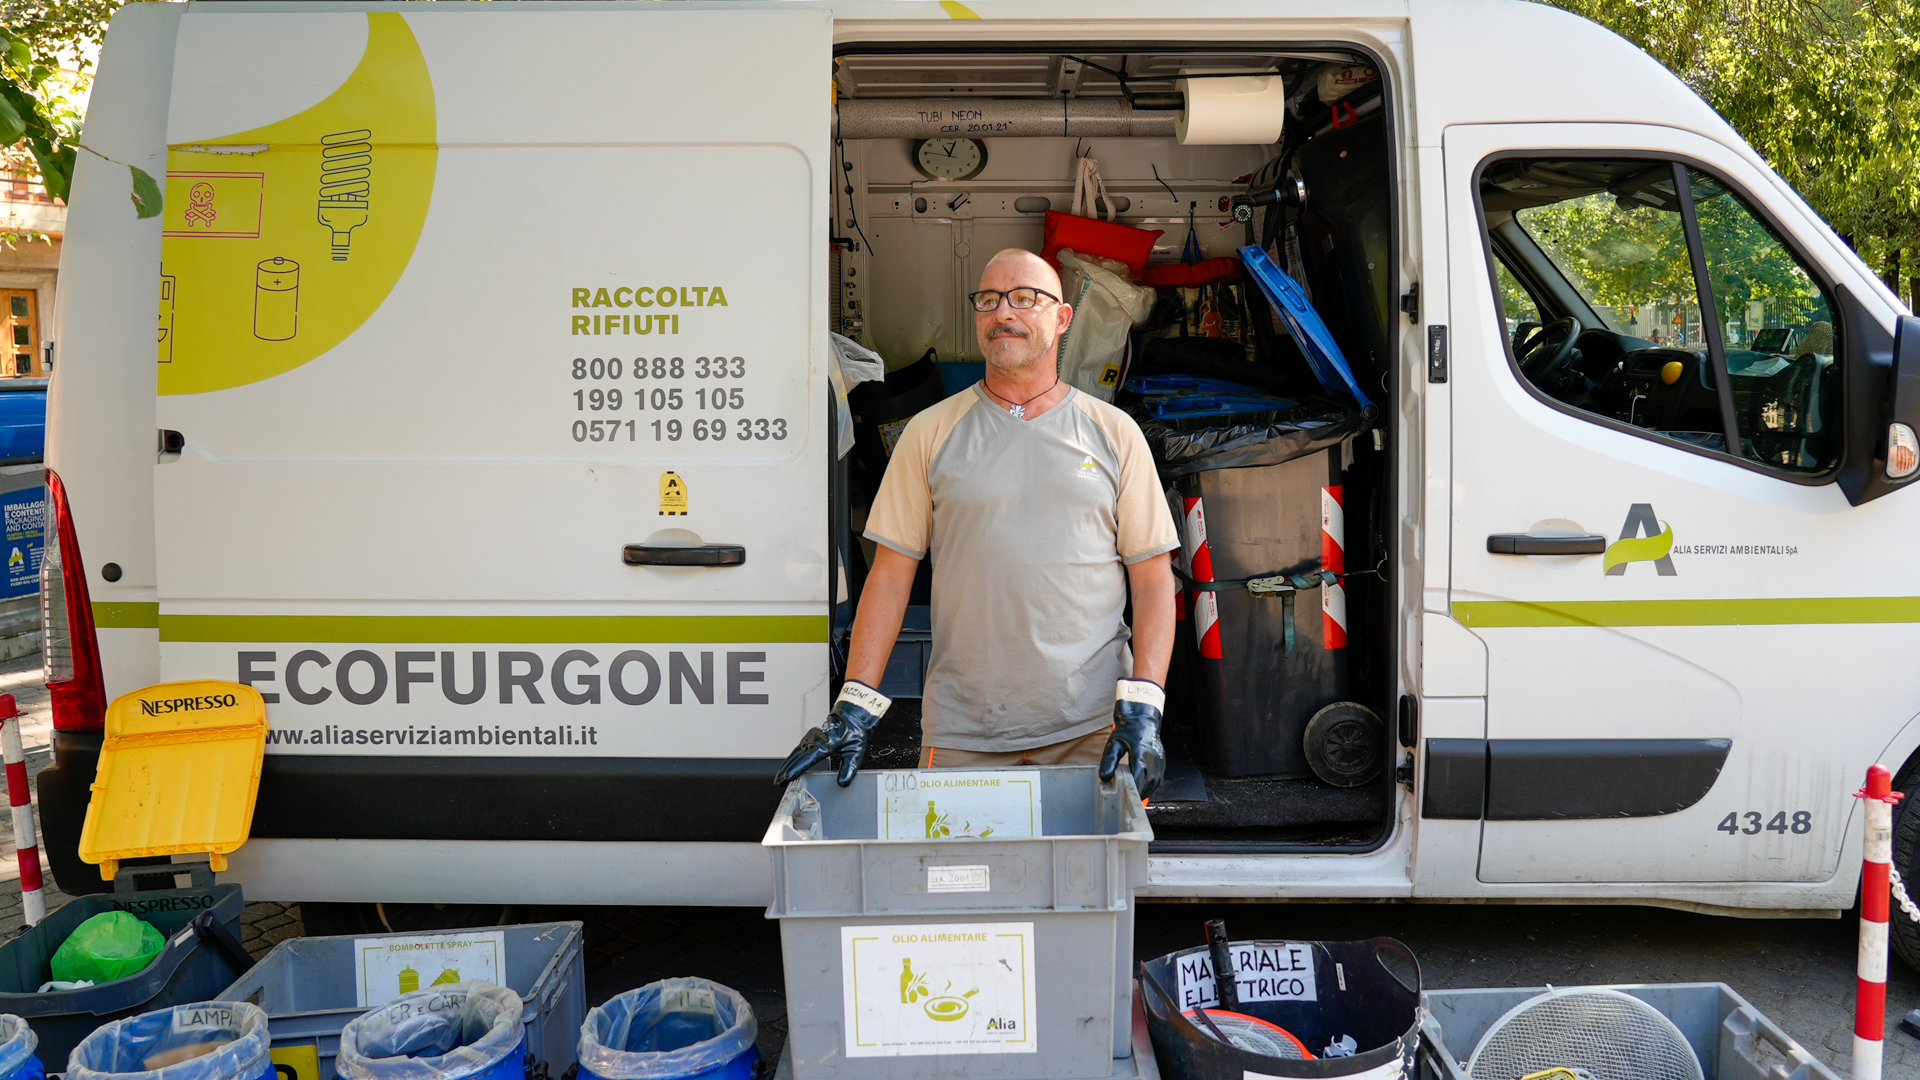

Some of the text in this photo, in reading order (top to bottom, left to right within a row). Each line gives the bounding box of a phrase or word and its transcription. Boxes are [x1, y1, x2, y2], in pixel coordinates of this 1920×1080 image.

[918, 110, 983, 123] TUBI NEON
[940, 125, 960, 133] CER
[571, 286, 728, 308] RACCOLTA
[571, 314, 679, 335] RIFIUTI
[571, 356, 746, 380] 800 888 333
[1102, 368, 1118, 382] R
[573, 388, 745, 411] 199 105 105
[571, 418, 788, 442] 0571 19 69 333
[5, 511, 10, 519] E
[5, 514, 45, 526] PACKAGING
[6, 524, 21, 533] AND
[1673, 545, 1798, 556] ALIA SERVIZI AMBIENTALI SpA
[237, 649, 770, 706] ECOFURGONE
[138, 694, 237, 717] NESPRESSO
[265, 725, 598, 746] ww.aliaserviziambientali.it
[884, 773, 918, 792] OLIO
[920, 778, 1002, 789] OLIO ALIMENTARE
[1717, 810, 1812, 836] 4348
[111, 895, 214, 914] NESPRESSO
[389, 940, 474, 952] BOMBOLETTE SPRAY
[892, 932, 988, 944] OLIO ALIMENTARE
[1182, 949, 1307, 986] MARIALE
[1185, 978, 1305, 1007] ELETRICO
[986, 1017, 1017, 1031] Alia
